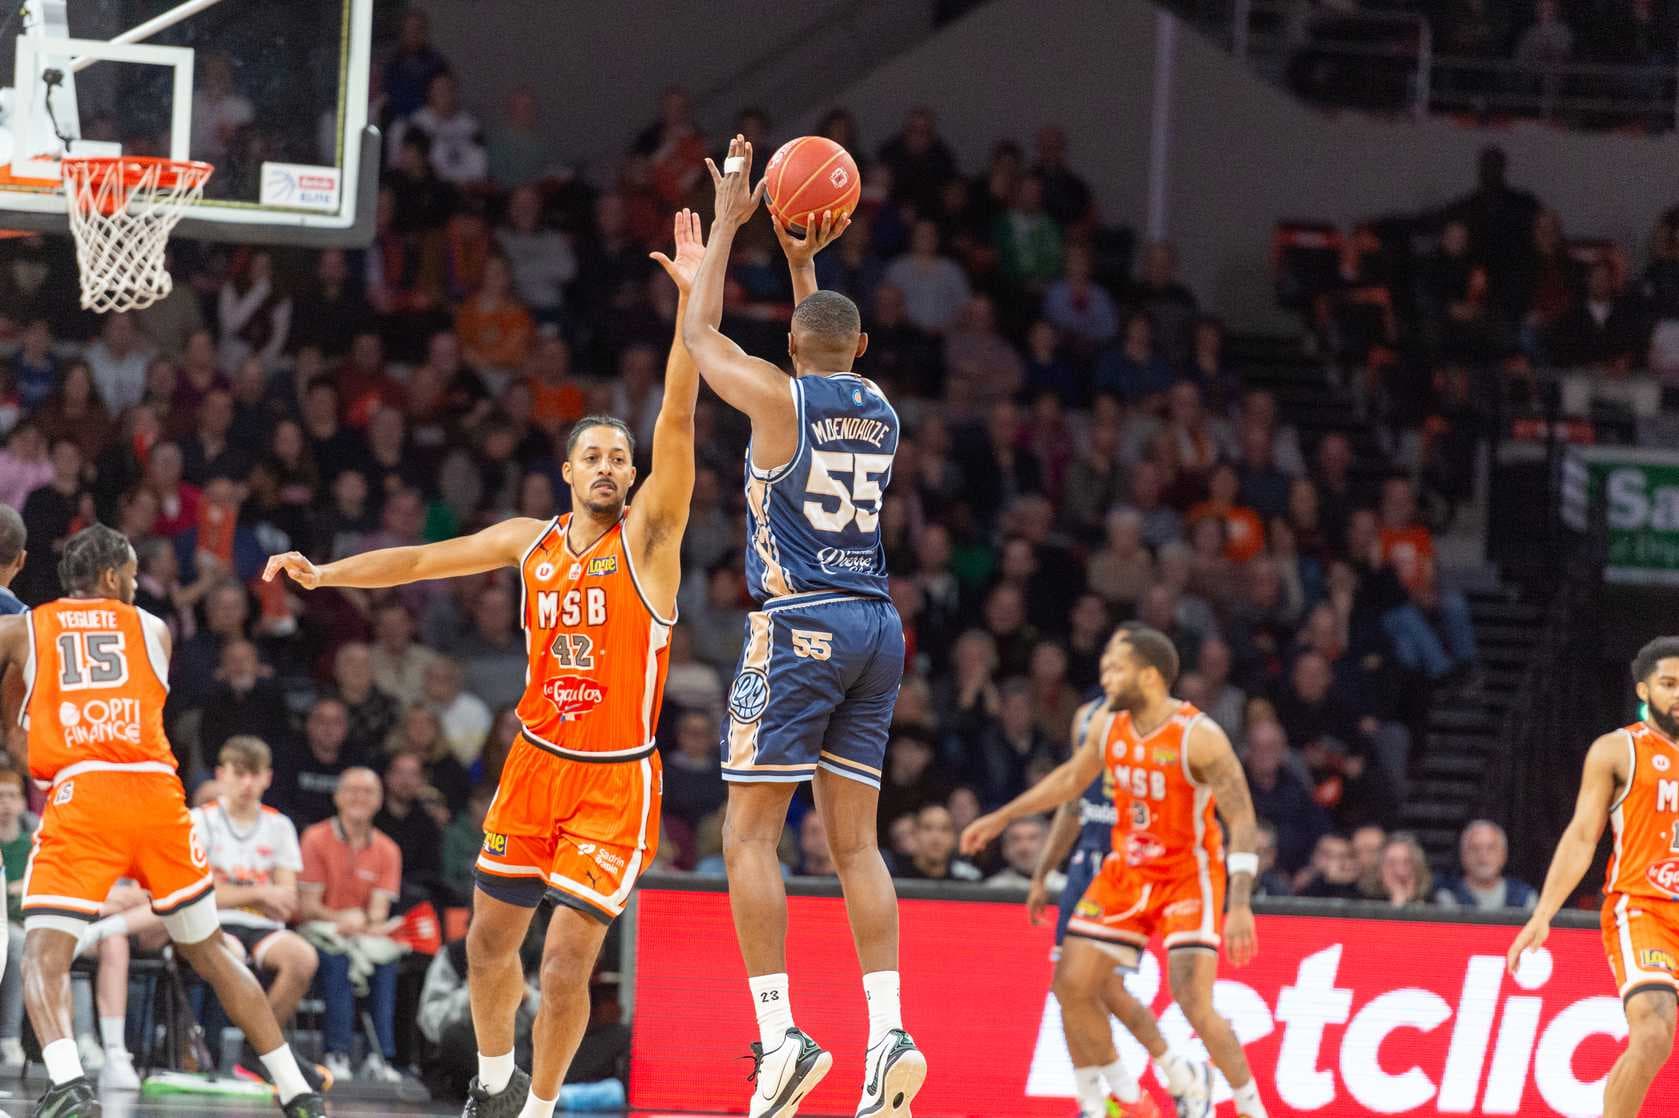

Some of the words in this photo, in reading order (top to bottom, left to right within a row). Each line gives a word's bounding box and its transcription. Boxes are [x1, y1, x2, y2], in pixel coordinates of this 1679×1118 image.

[803, 448, 894, 533] 55
[57, 610, 117, 628] YEGUETE
[537, 587, 607, 629] MSB
[56, 632, 129, 691] 15
[551, 633, 594, 670] 42
[791, 628, 833, 661] 55
[83, 697, 141, 723] OPTI
[760, 990, 780, 1003] 23
